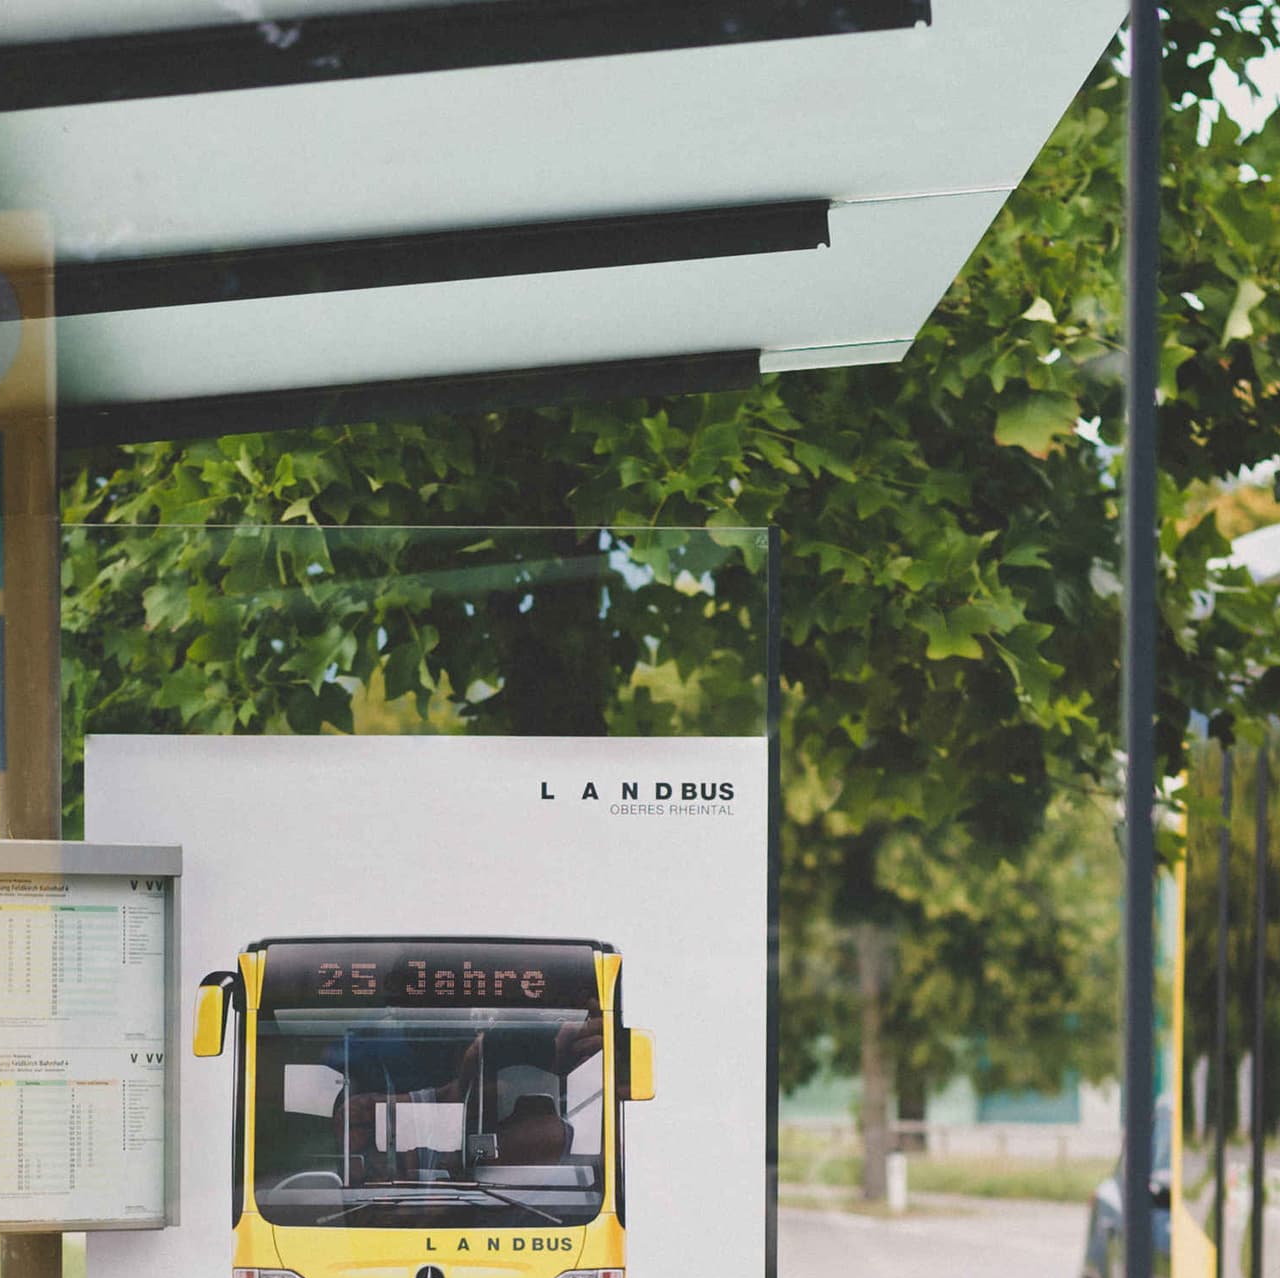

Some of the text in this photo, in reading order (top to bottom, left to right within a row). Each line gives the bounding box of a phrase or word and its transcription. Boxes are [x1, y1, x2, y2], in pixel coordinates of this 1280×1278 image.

[540, 781, 735, 801] LANDBUS
[609, 804, 735, 816] OBERES RHEINTAL
[317, 960, 546, 999] 25 Jahre
